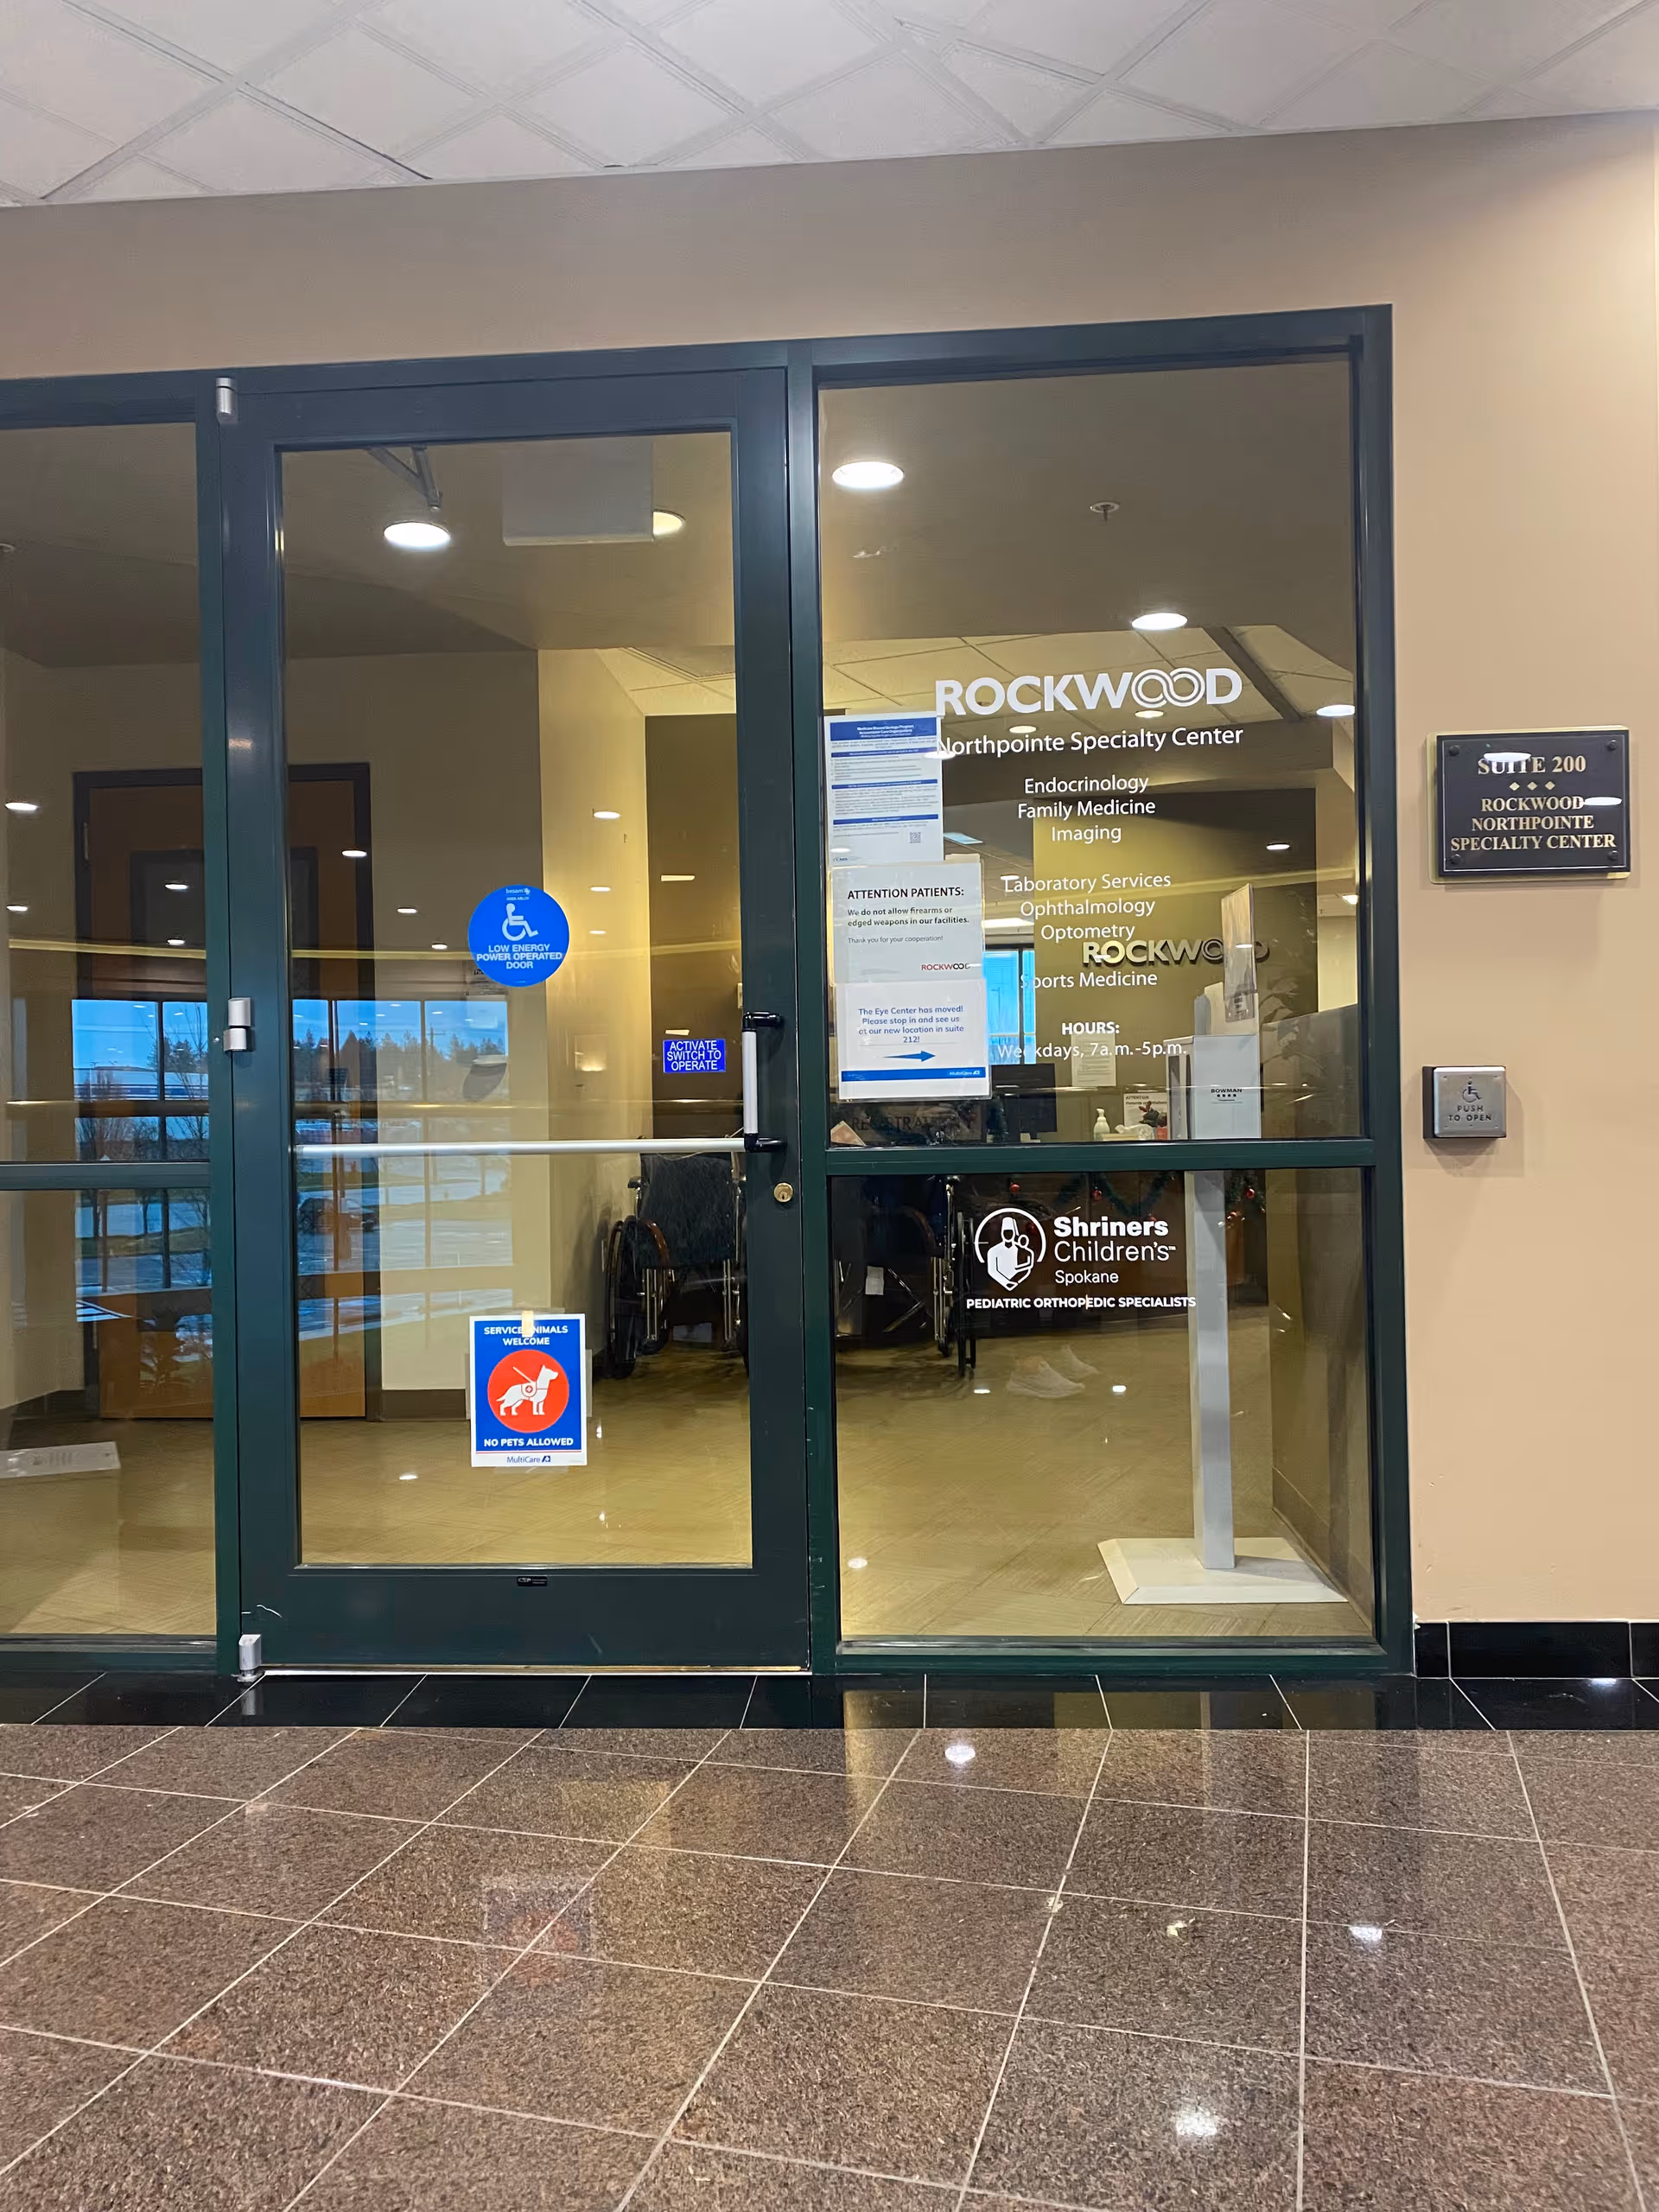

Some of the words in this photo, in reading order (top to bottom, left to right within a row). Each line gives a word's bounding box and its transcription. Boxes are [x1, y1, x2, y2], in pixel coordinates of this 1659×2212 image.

[936, 667, 1243, 715] ROCKWOOD
[938, 734, 1065, 758] Northpointe
[1071, 730, 1166, 754] Specialty
[1172, 727, 1243, 746] Center
[1478, 755, 1546, 775] SUITE
[1551, 755, 1586, 772] 200
[1025, 774, 1149, 793] Endocrinology
[1018, 801, 1072, 821] Family
[1077, 799, 1156, 817] Medicine
[1481, 796, 1586, 812] ROCKWOOD
[1471, 815, 1594, 832] NORTHPOINTE
[1052, 825, 1122, 844] Imaging
[1451, 835, 1543, 851] SPECIALTY
[1546, 834, 1617, 849] CENTER
[1005, 876, 1096, 893] Laboratory
[1102, 873, 1172, 889] Services
[848, 888, 908, 899] ATTENTION
[911, 887, 964, 898] PATIENTS:
[1020, 898, 1155, 919] Ophthalmology
[848, 918, 873, 928] edged
[874, 918, 908, 927] weapons
[934, 916, 969, 925] facilities.
[1040, 924, 1135, 944] Optometry
[476, 953, 511, 962] POWER
[513, 951, 563, 961] OPERATED
[488, 944, 510, 953] LOW
[512, 944, 550, 952] ENERGY
[1079, 970, 1158, 988] Medicine
[874, 1007, 889, 1017] Eye
[1061, 1021, 1120, 1035] HOURS:
[670, 1039, 718, 1051] ACTIVATE
[666, 1050, 705, 1061] SWITCH
[707, 1050, 721, 1059] TO
[671, 1059, 718, 1071] OPERATE
[1053, 1216, 1169, 1237] Shriners
[1054, 1269, 1119, 1286] Spokane
[966, 1298, 1033, 1309] PEDIATRIC
[1033, 1297, 1116, 1308] ORTHOPEDIC
[1118, 1296, 1197, 1308] SPECIALISTS
[484, 1326, 523, 1335] SERVICE
[531, 1325, 569, 1334] NIMALS
[503, 1337, 550, 1346] WELCOME
[484, 1439, 499, 1447] NO
[501, 1438, 524, 1446] PETS
[526, 1437, 574, 1446] ALLOWED
